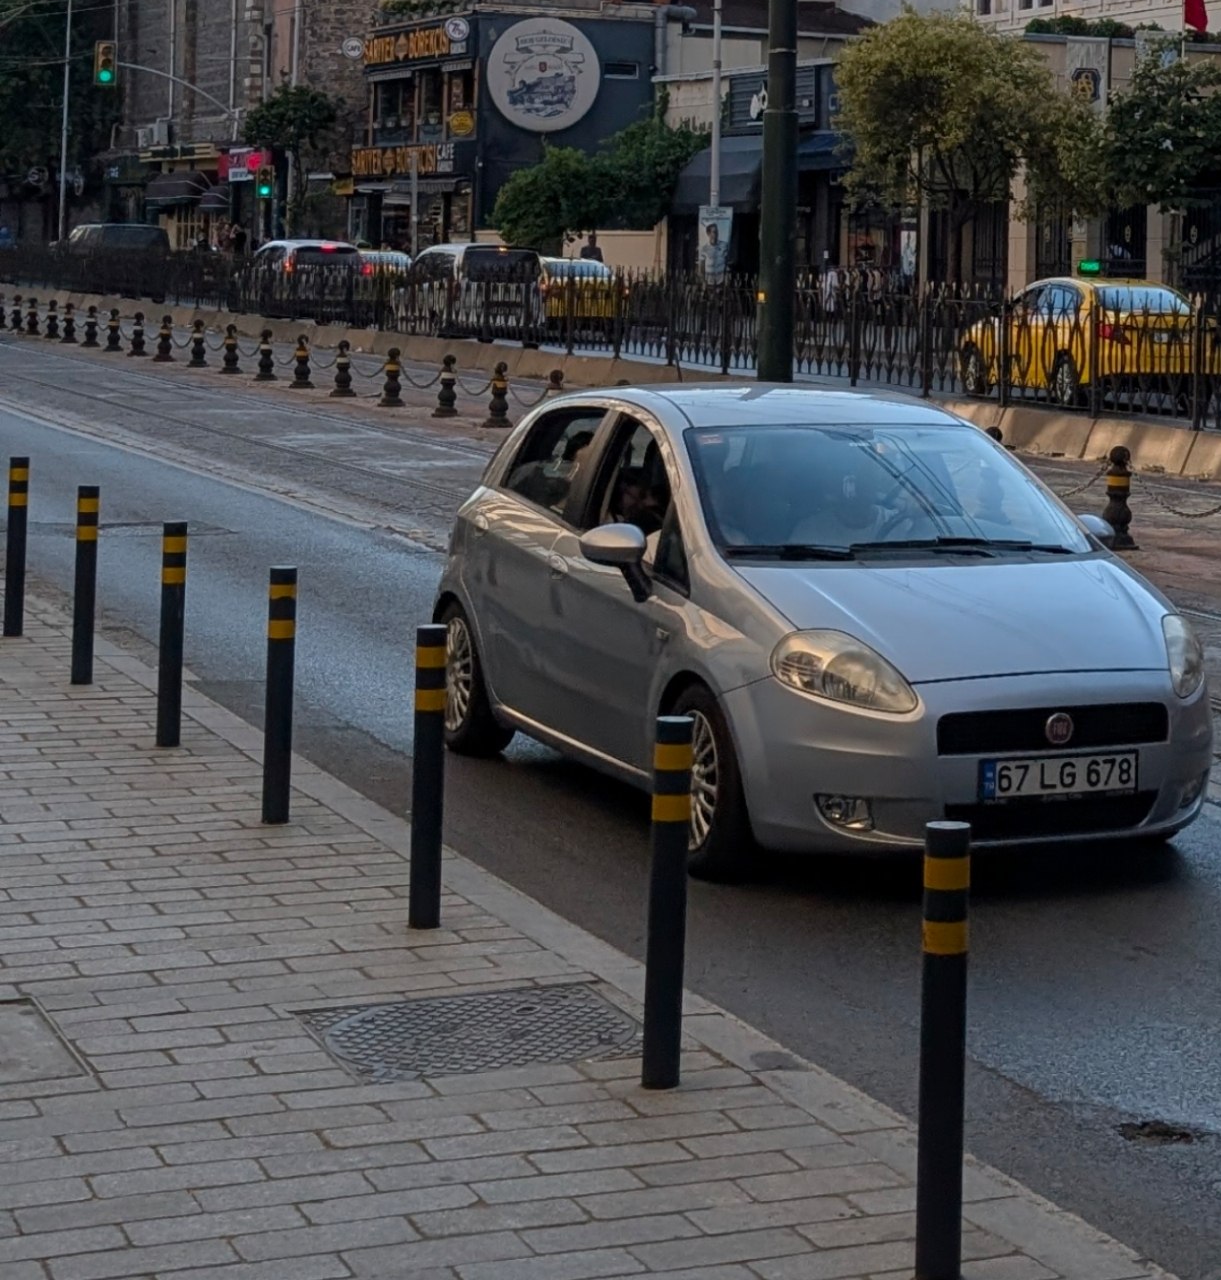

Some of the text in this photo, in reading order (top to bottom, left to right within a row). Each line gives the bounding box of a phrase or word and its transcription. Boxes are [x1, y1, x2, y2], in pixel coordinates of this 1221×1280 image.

[437, 143, 455, 160] CAFE
[998, 757, 1132, 792] 67 LG 678
